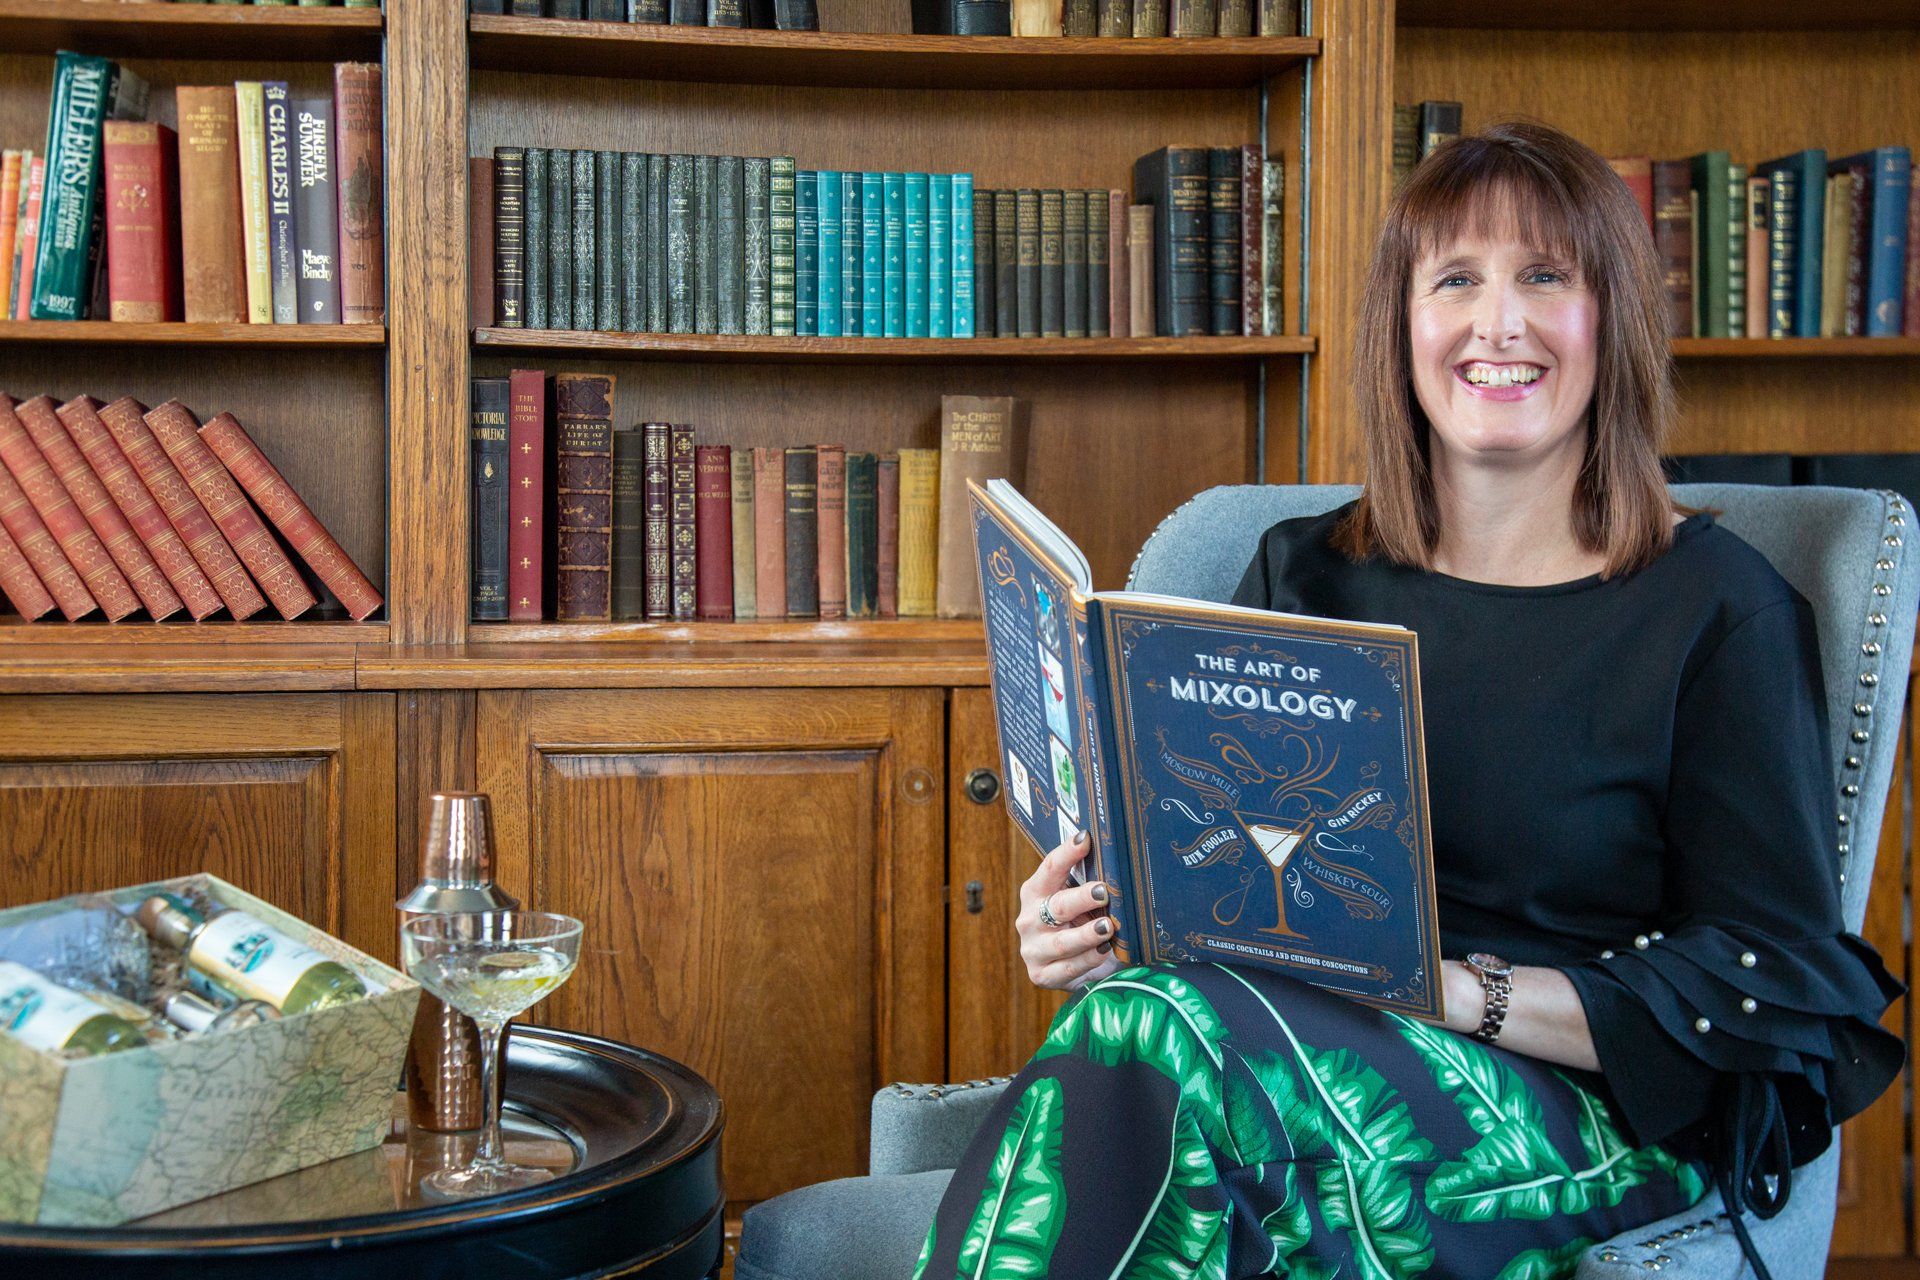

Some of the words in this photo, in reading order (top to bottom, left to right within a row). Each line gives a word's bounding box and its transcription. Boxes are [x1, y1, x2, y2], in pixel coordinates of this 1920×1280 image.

[61, 64, 100, 187] MILLER'S
[269, 103, 290, 199] CHARLES
[298, 112, 316, 188] SUMMER
[313, 118, 328, 183] FIREFLY
[64, 183, 85, 250] Antiques
[272, 201, 290, 216] II
[278, 219, 289, 262] Christopher
[302, 249, 332, 265] Maeve
[302, 264, 333, 281] Binchy
[519, 394, 535, 403] THE
[952, 412, 966, 422] The
[967, 411, 1002, 423] CHRIST
[513, 414, 538, 422] STORY
[951, 422, 962, 431] of
[963, 422, 979, 431] the
[951, 432, 972, 441] MEN
[972, 432, 983, 441] of
[983, 432, 1002, 441] ART
[1195, 652, 1238, 673] THE
[1243, 659, 1285, 679] ART
[1290, 665, 1322, 684] OF
[1169, 675, 1358, 723] MIXOLOGY
[1091, 749, 1097, 759] OF
[1093, 760, 1106, 824] MIXOLOGY
[1161, 751, 1208, 780] MOSCOW
[1210, 774, 1240, 799] MULE
[1327, 814, 1351, 829] GIN
[1346, 791, 1383, 820] RICKEY
[1182, 851, 1206, 867] RUM
[1200, 828, 1239, 854] COOLER
[1302, 856, 1360, 891] WHISKEY
[1360, 883, 1391, 909] SOUR
[1207, 938, 1236, 952] CLASSIC
[1236, 942, 1275, 958] COCKTAILS
[1275, 950, 1291, 961] AND
[1290, 953, 1322, 967] CURIOUS
[1320, 958, 1370, 976] CONCOCTIONS
